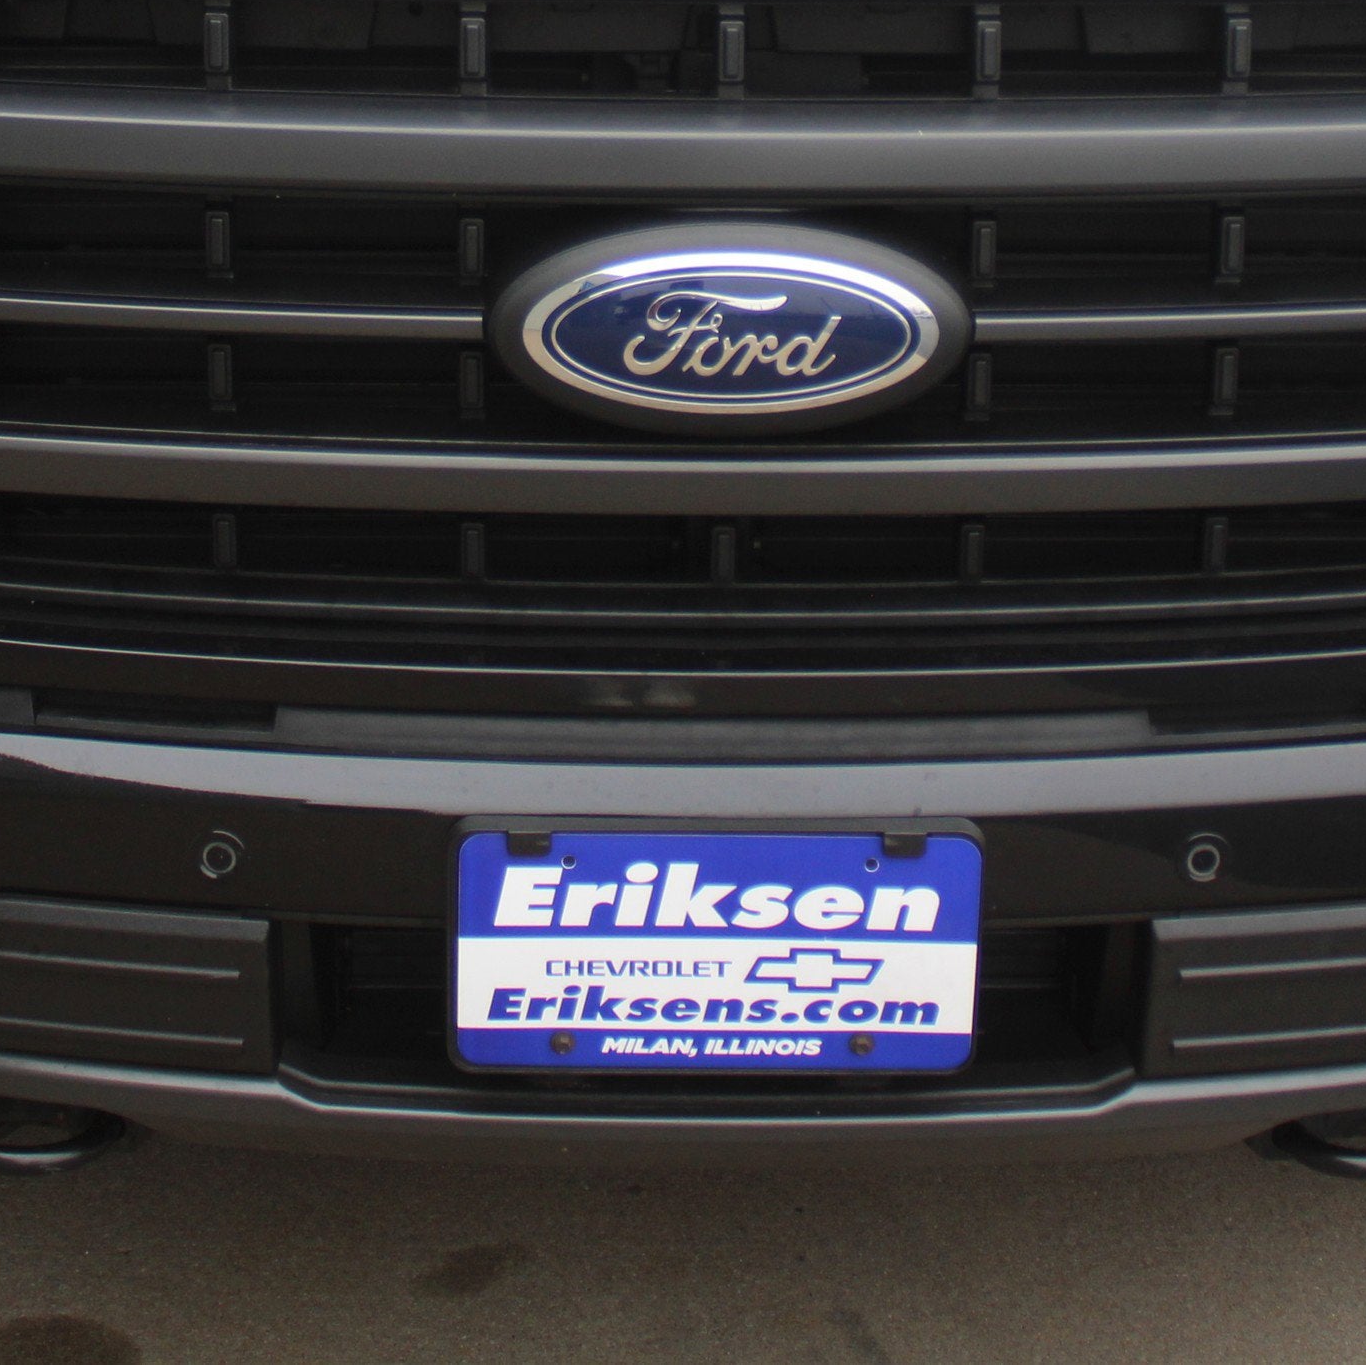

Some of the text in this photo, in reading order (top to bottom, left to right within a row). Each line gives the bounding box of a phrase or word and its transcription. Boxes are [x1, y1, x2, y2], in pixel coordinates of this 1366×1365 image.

[622, 290, 842, 377] Ford
[493, 861, 941, 932] Eriksen
[545, 959, 733, 978] CHEVROLET
[486, 985, 941, 1026] Eriksens.com
[600, 1036, 823, 1058] MILAN, ILLINOIS
